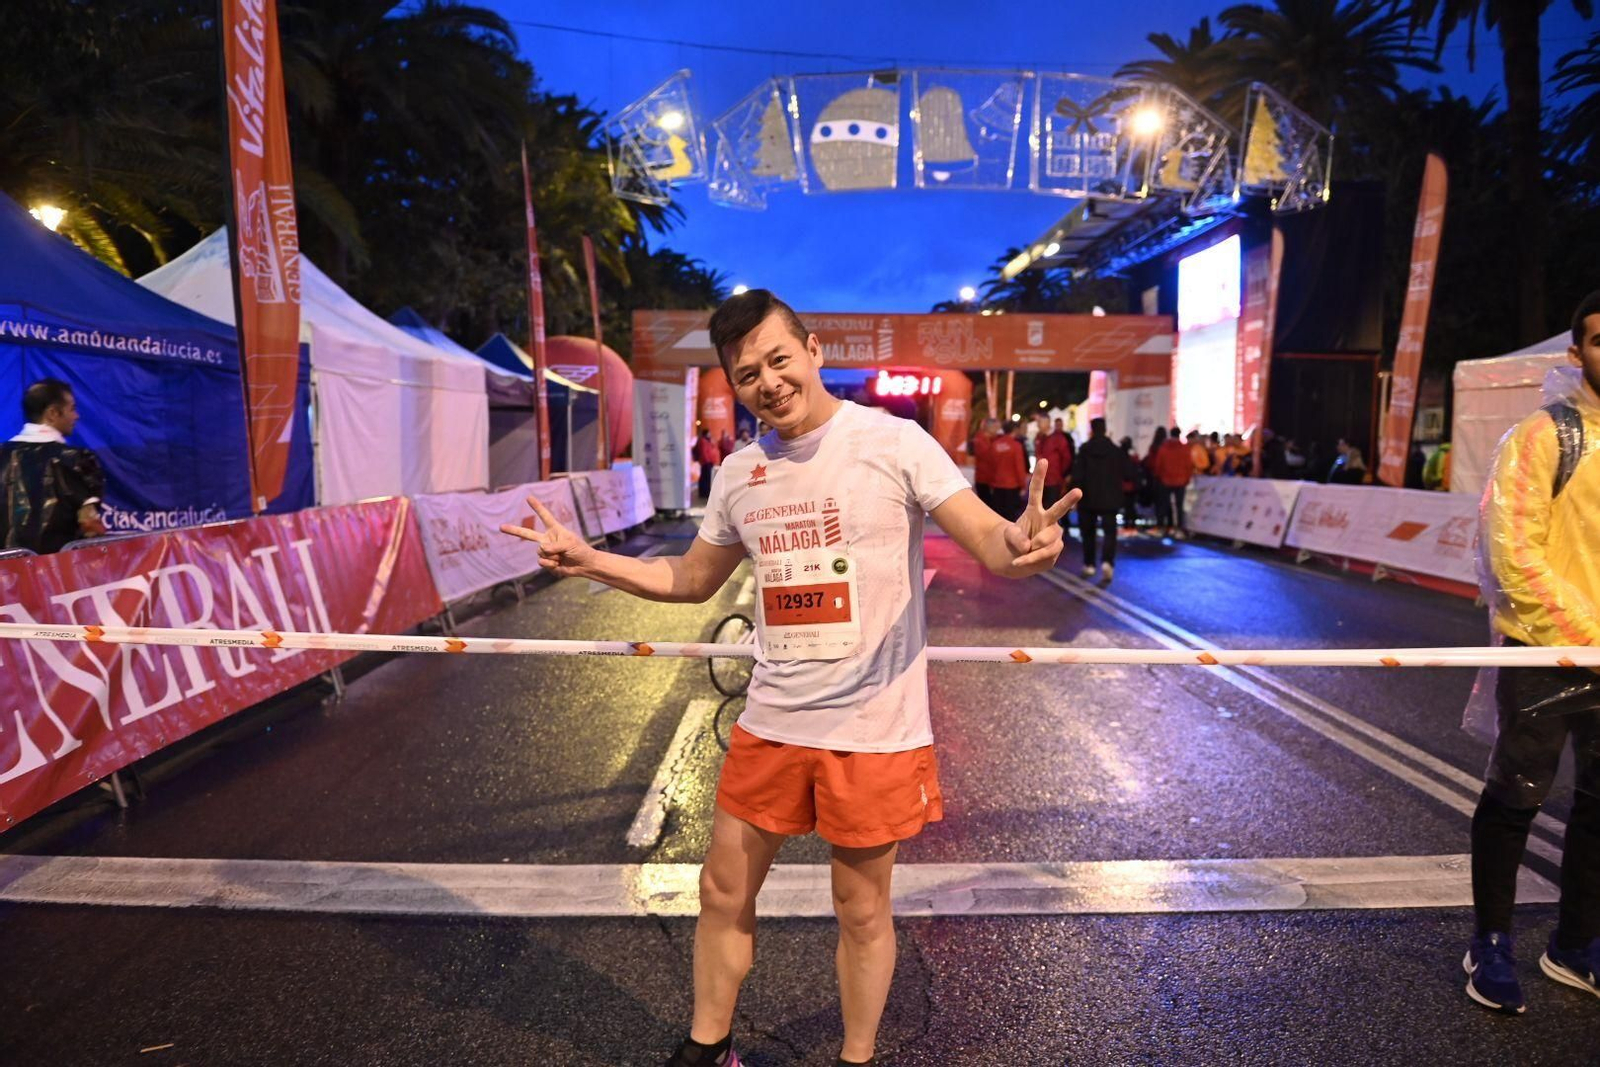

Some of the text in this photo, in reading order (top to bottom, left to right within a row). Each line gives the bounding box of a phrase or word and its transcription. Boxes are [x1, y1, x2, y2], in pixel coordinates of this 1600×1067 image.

[268, 183, 300, 304] GENERALI
[756, 501, 816, 521] GENERALI
[759, 529, 821, 555] MÁLAGA
[803, 563, 821, 572] 21K
[775, 591, 825, 610] 12937
[33, 631, 78, 639] ATRESMEDIA
[391, 644, 438, 652] ATRESMEDIA
